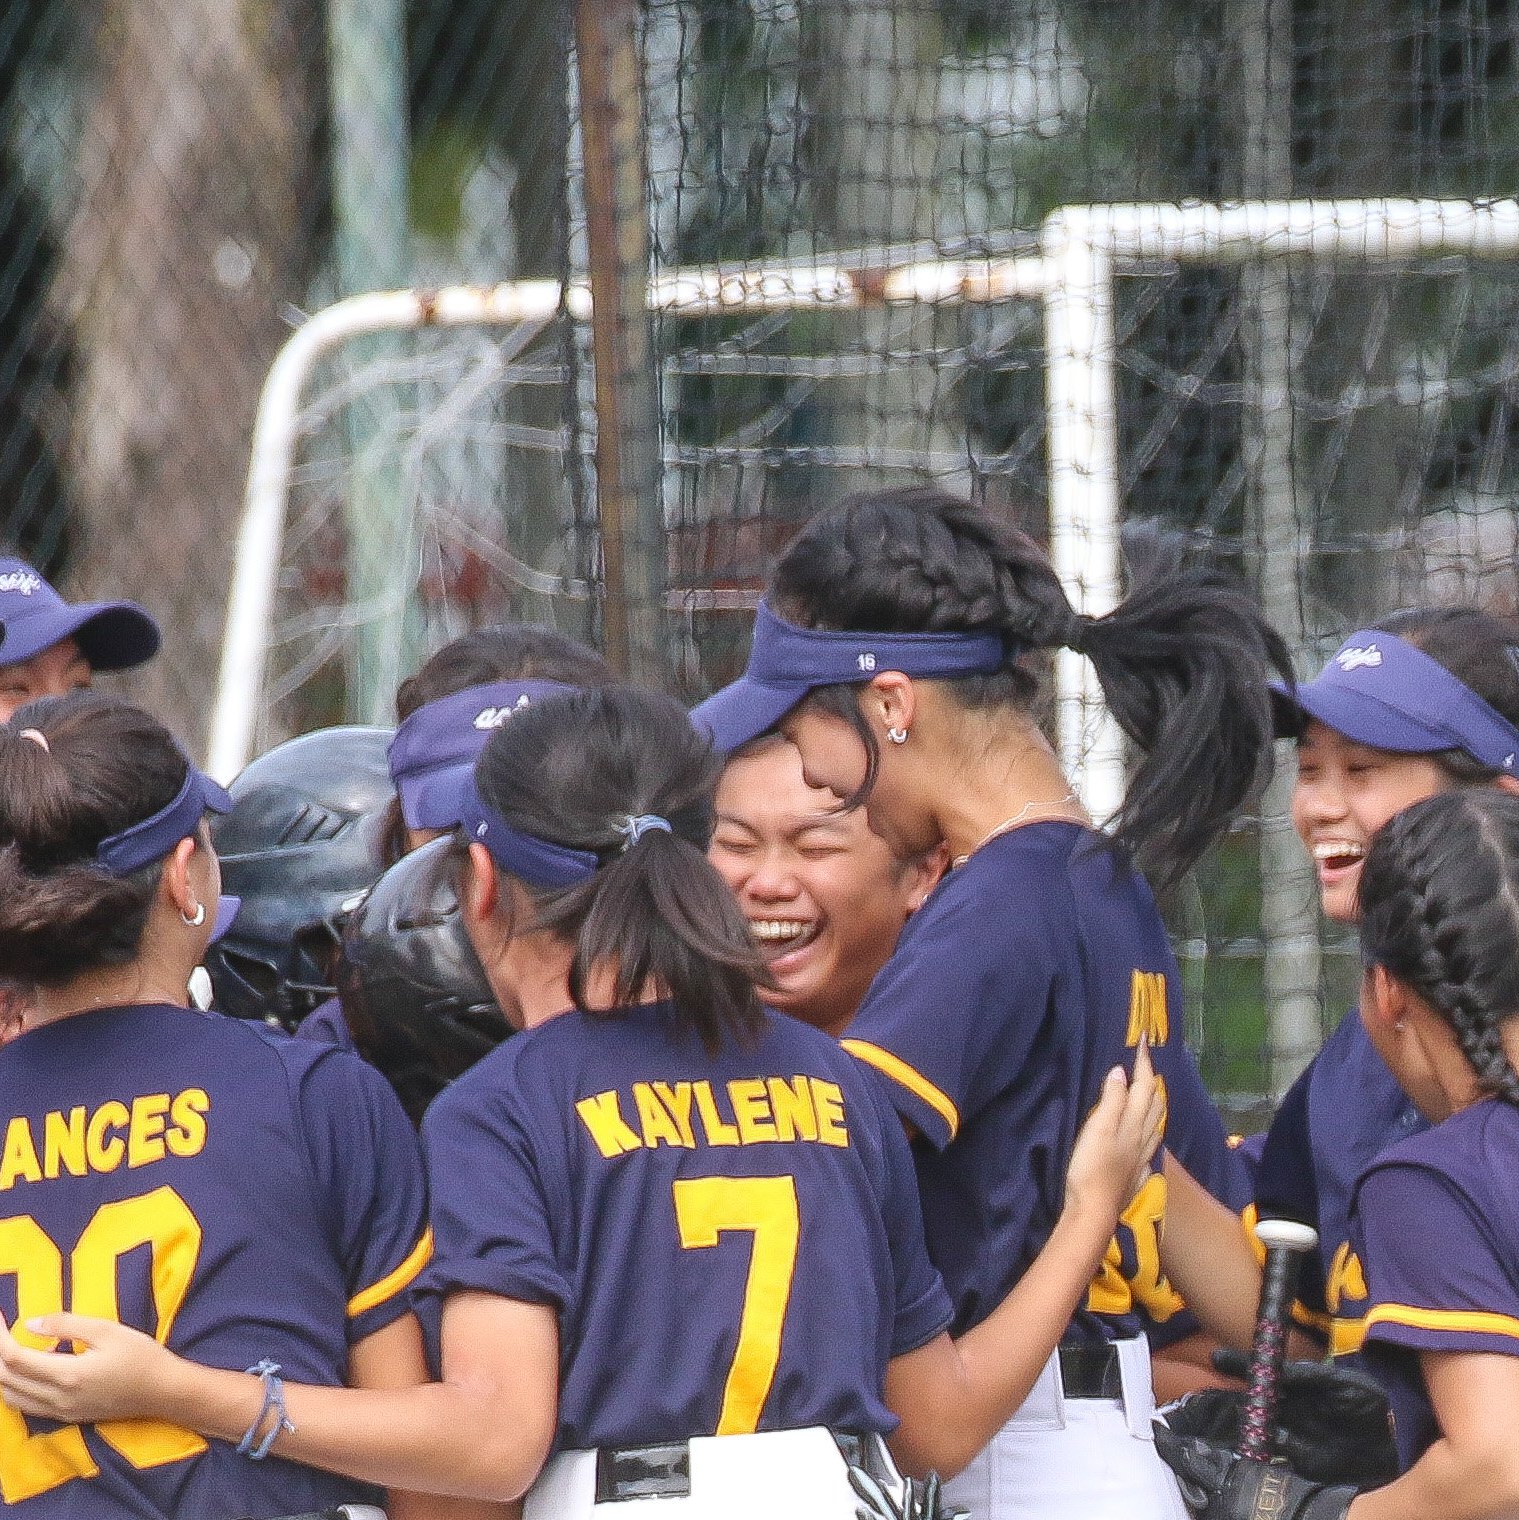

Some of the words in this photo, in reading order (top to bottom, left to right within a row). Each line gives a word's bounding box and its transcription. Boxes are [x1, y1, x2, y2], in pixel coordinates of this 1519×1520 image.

[856, 652, 876, 672] 16
[575, 1075, 849, 1159] KAYLENE
[673, 1175, 800, 1438] 7
